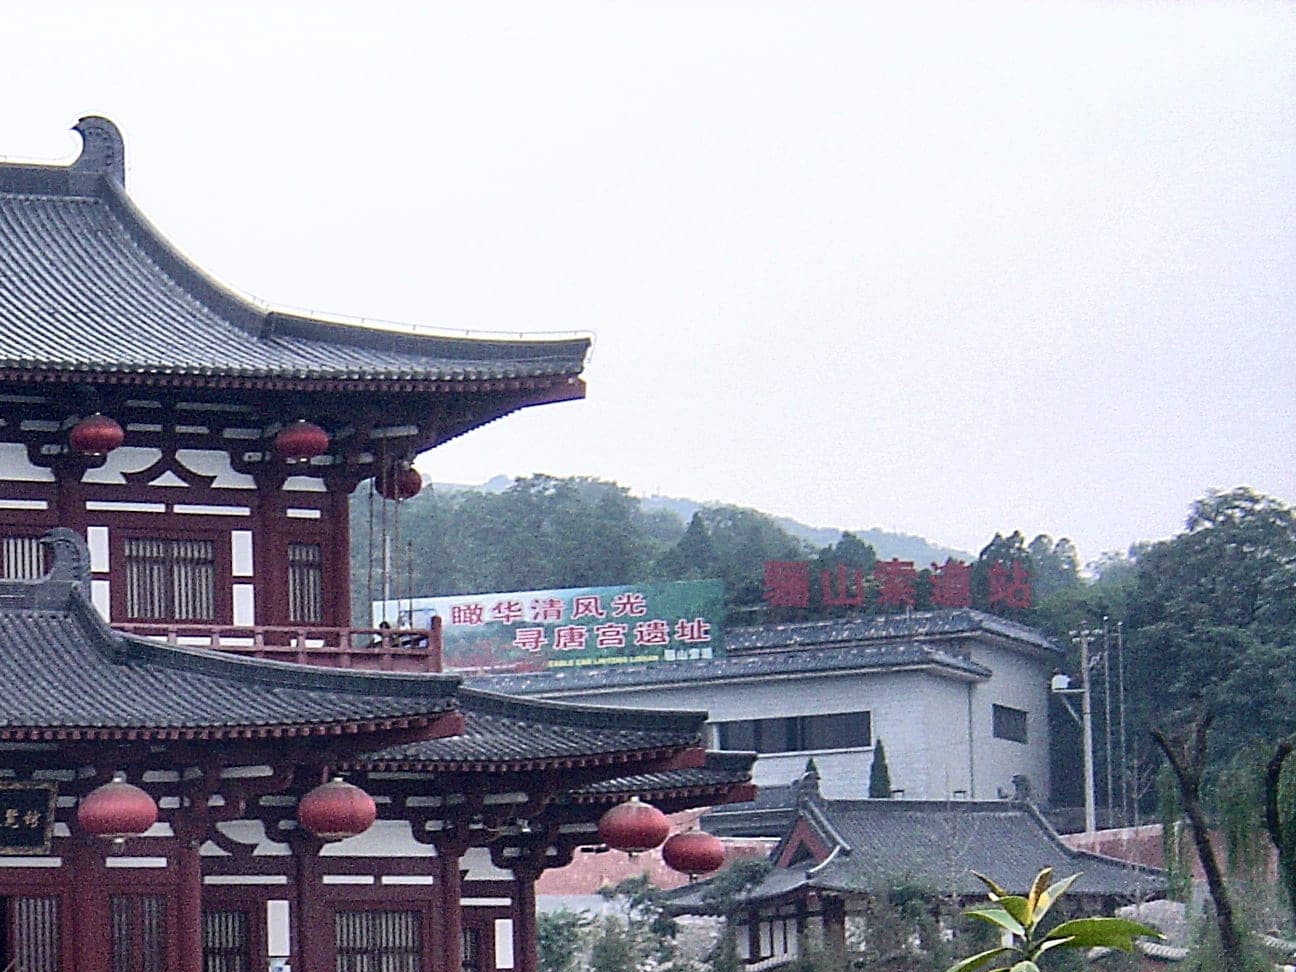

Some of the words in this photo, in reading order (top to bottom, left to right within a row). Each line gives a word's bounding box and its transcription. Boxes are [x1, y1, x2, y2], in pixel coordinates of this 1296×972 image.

[452, 593, 647, 625] 瞰华清风光
[513, 617, 712, 651] 寻唐宫遗址
